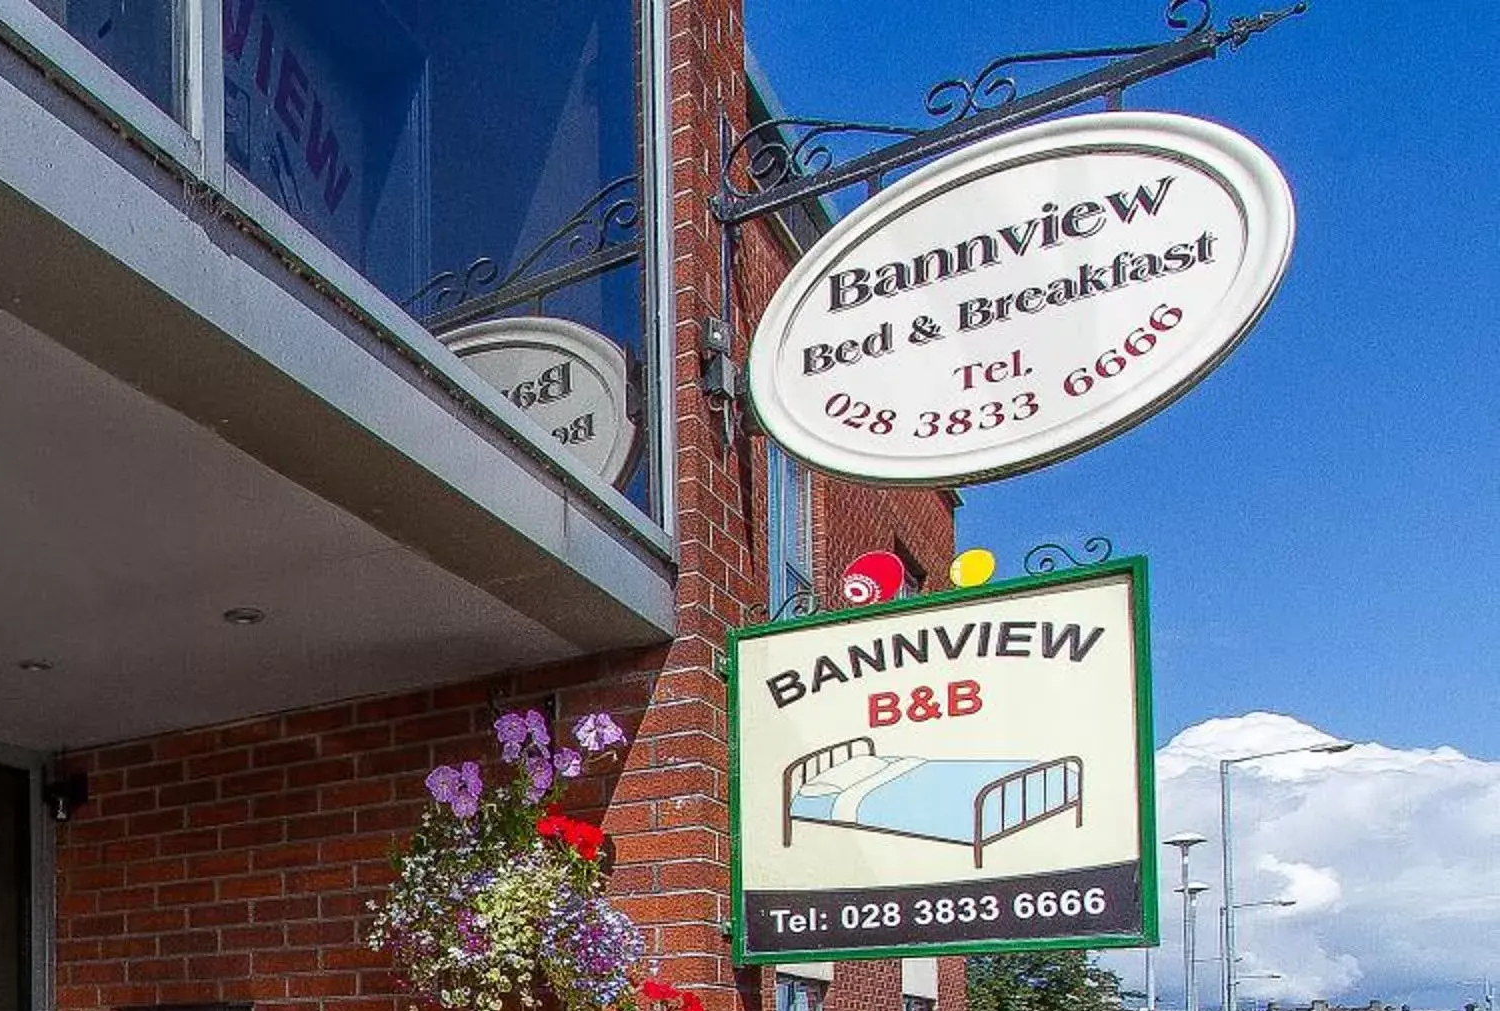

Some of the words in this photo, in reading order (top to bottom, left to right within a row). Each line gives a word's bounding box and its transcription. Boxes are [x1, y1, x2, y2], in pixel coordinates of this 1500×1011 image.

[803, 321, 894, 376] Bed
[908, 315, 941, 346] &
[958, 231, 1216, 333] Breakfast
[824, 392, 897, 436] 028
[913, 392, 1039, 439] 3833
[1064, 303, 1183, 397] 6666
[954, 351, 1033, 391] Tel.
[766, 621, 1104, 709] BANNVIEW
[867, 679, 983, 728] B&B
[770, 909, 828, 934] Tel:
[841, 903, 900, 929] 028
[914, 895, 998, 924] 3833
[1013, 889, 1105, 917] 6666
